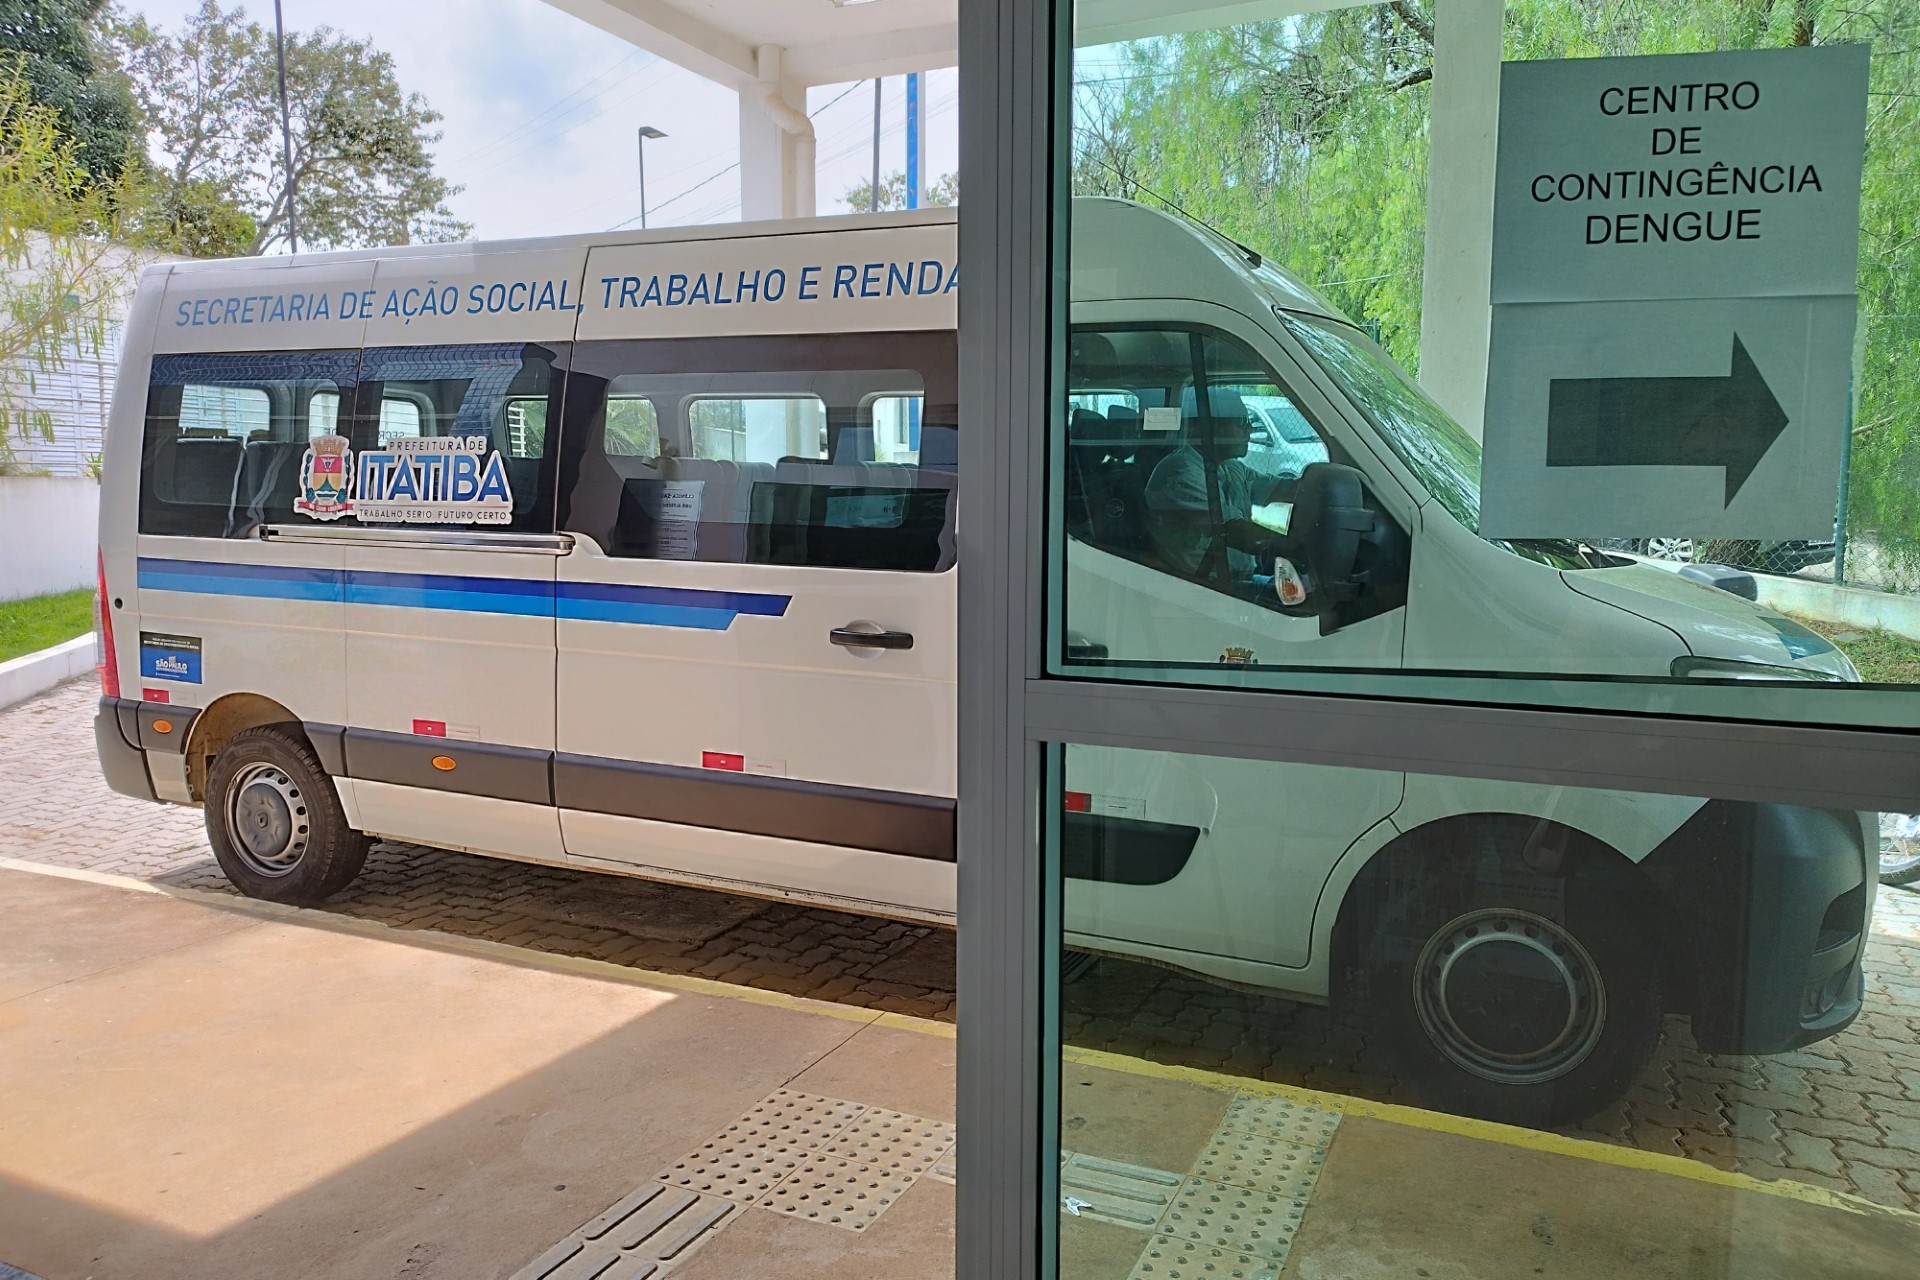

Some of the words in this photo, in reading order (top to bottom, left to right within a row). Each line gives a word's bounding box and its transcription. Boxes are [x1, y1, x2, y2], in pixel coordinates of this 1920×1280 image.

[1599, 80, 1760, 116] CENTRO
[1651, 126, 1702, 156] DE
[1531, 161, 1823, 203] CONTINGÊNCIA
[1585, 208, 1762, 245] DENGUE
[175, 293, 330, 328] SECRETARIA
[339, 289, 377, 319] DE
[382, 280, 460, 326] AÇÃO
[466, 279, 584, 315] SOCIAL,
[600, 268, 787, 309] TRABALHO
[798, 266, 822, 300] E
[832, 260, 958, 298] RENDA
[389, 440, 463, 451] PREFEITURA
[469, 441, 484, 451] DE
[359, 454, 510, 502] ITATIBA
[359, 508, 403, 518] TRABALHO
[438, 510, 473, 520] FUTURO
